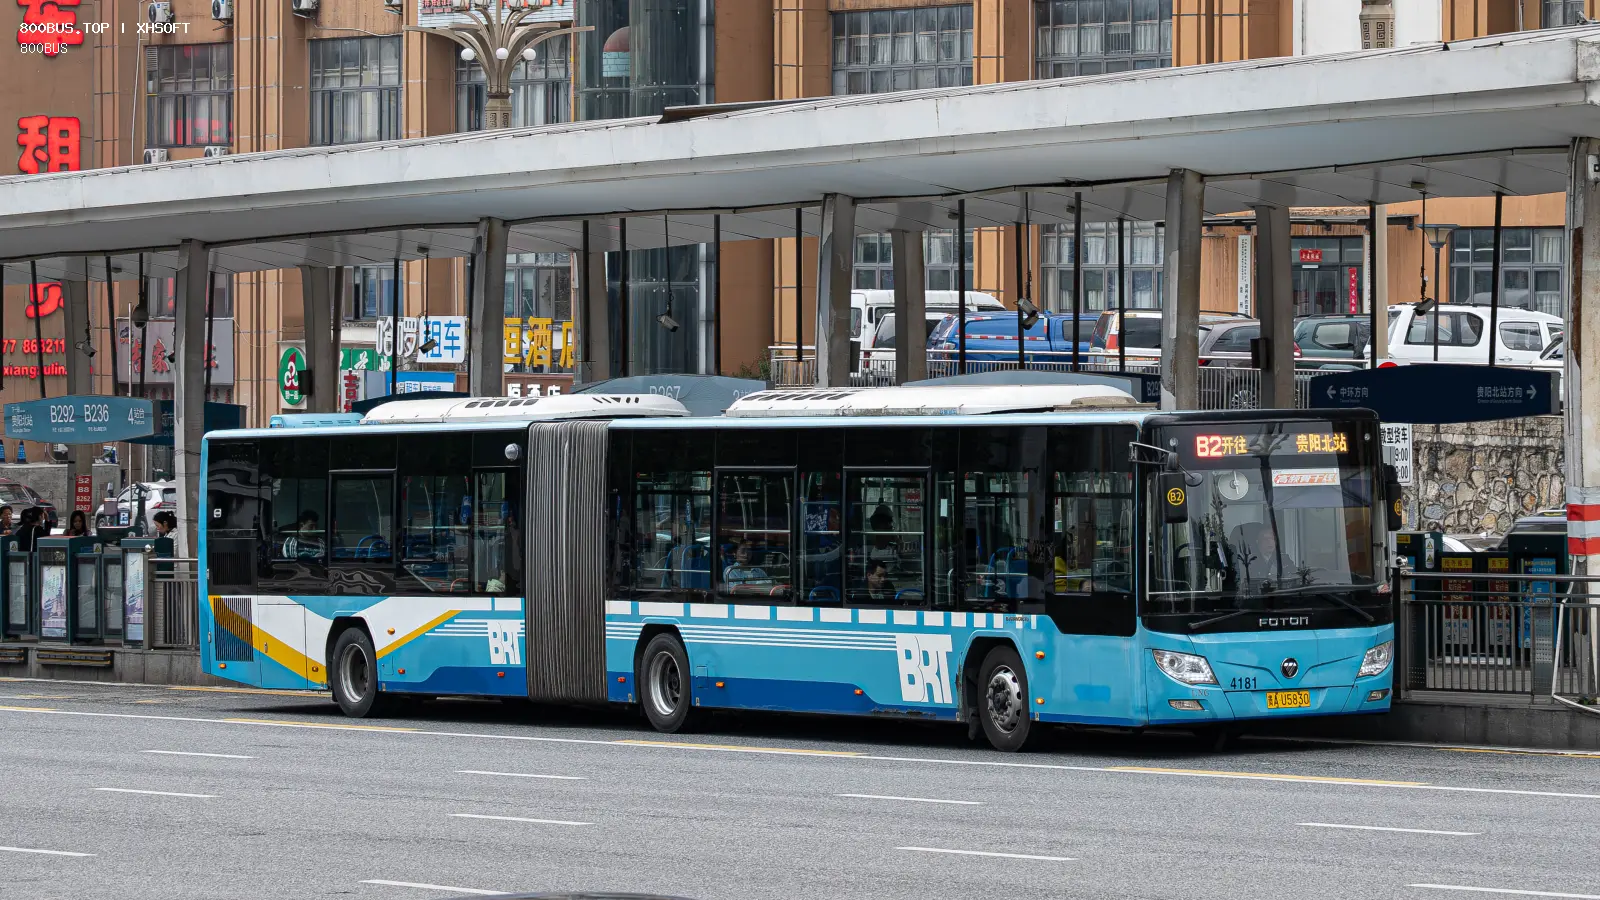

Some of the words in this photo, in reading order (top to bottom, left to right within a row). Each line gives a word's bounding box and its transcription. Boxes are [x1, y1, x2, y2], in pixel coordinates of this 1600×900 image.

[1146, 380, 1161, 397] B29
[1340, 386, 1369, 398] 中环方向
[1476, 386, 1523, 398] 贵阳北站方向
[50, 404, 75, 423] B292
[83, 404, 110, 423] B236
[127, 407, 134, 425] 4
[1296, 433, 1347, 453] 贵阳北站
[1170, 491, 1183, 502] B2
[1259, 616, 1309, 627] FOTON
[487, 619, 522, 665] BRT
[895, 633, 953, 704] BRT
[1230, 676, 1257, 690] 4181
